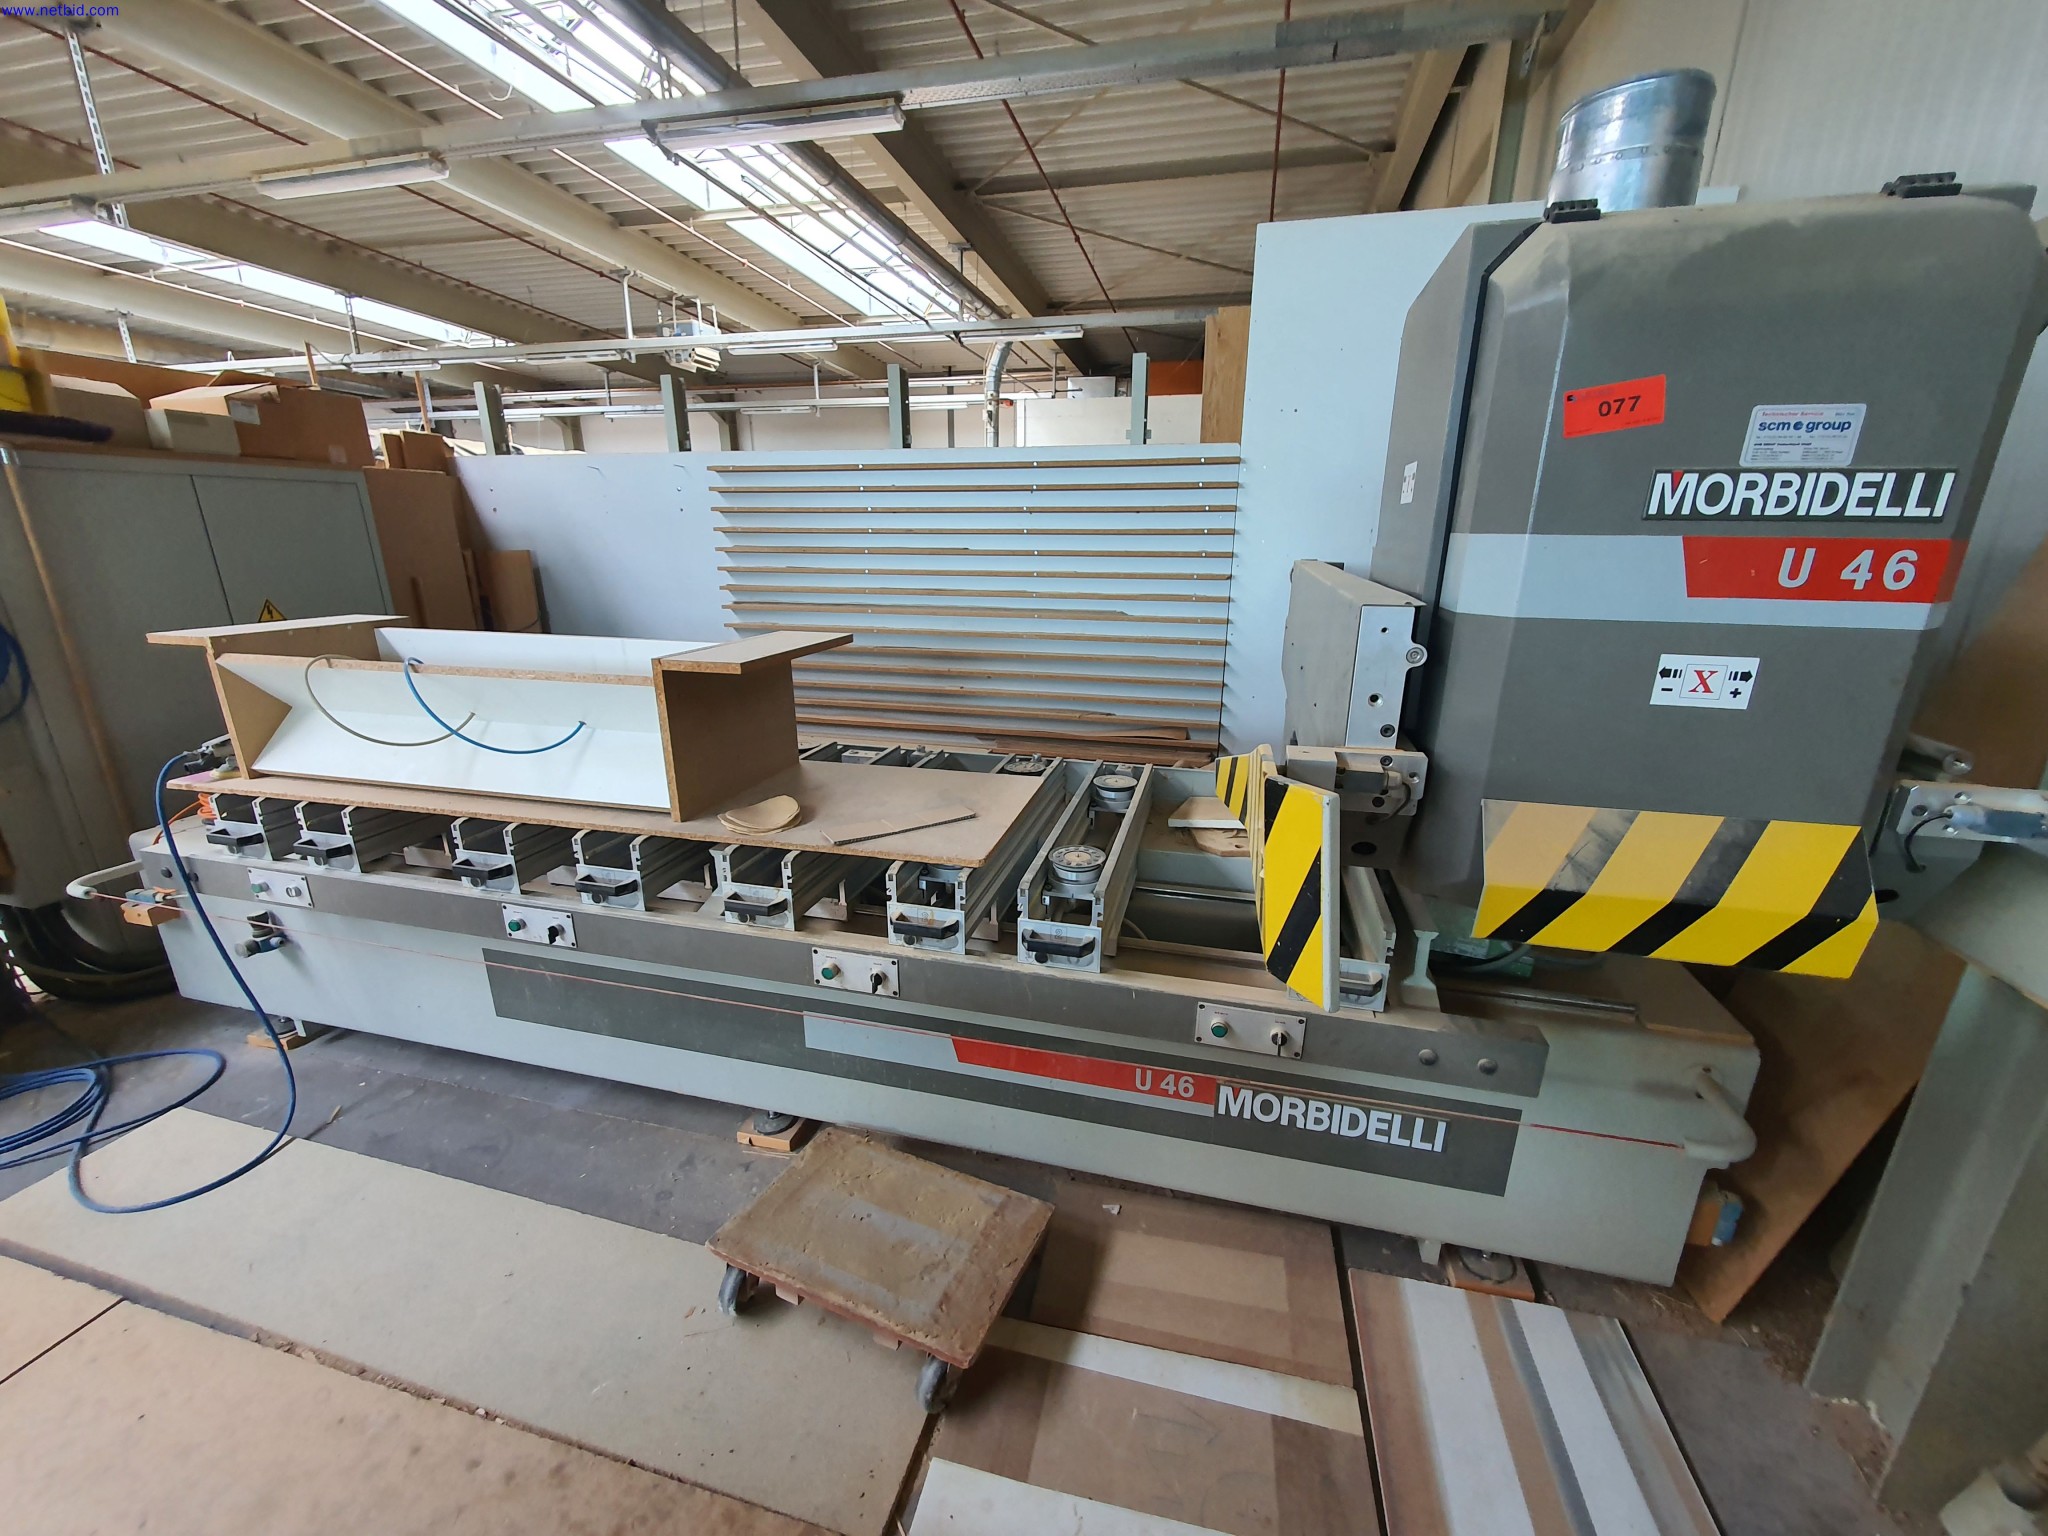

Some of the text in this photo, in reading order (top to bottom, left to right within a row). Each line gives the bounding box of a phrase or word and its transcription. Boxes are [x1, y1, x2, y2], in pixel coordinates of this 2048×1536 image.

[1598, 395, 1641, 417] 077
[1758, 420, 1852, 433] scm group
[1648, 472, 1956, 517] MORBIDELLI
[1777, 547, 1918, 590] U 46
[1688, 669, 1719, 694] X
[1135, 1068, 1447, 1153] U 46 MORBIDELLI
